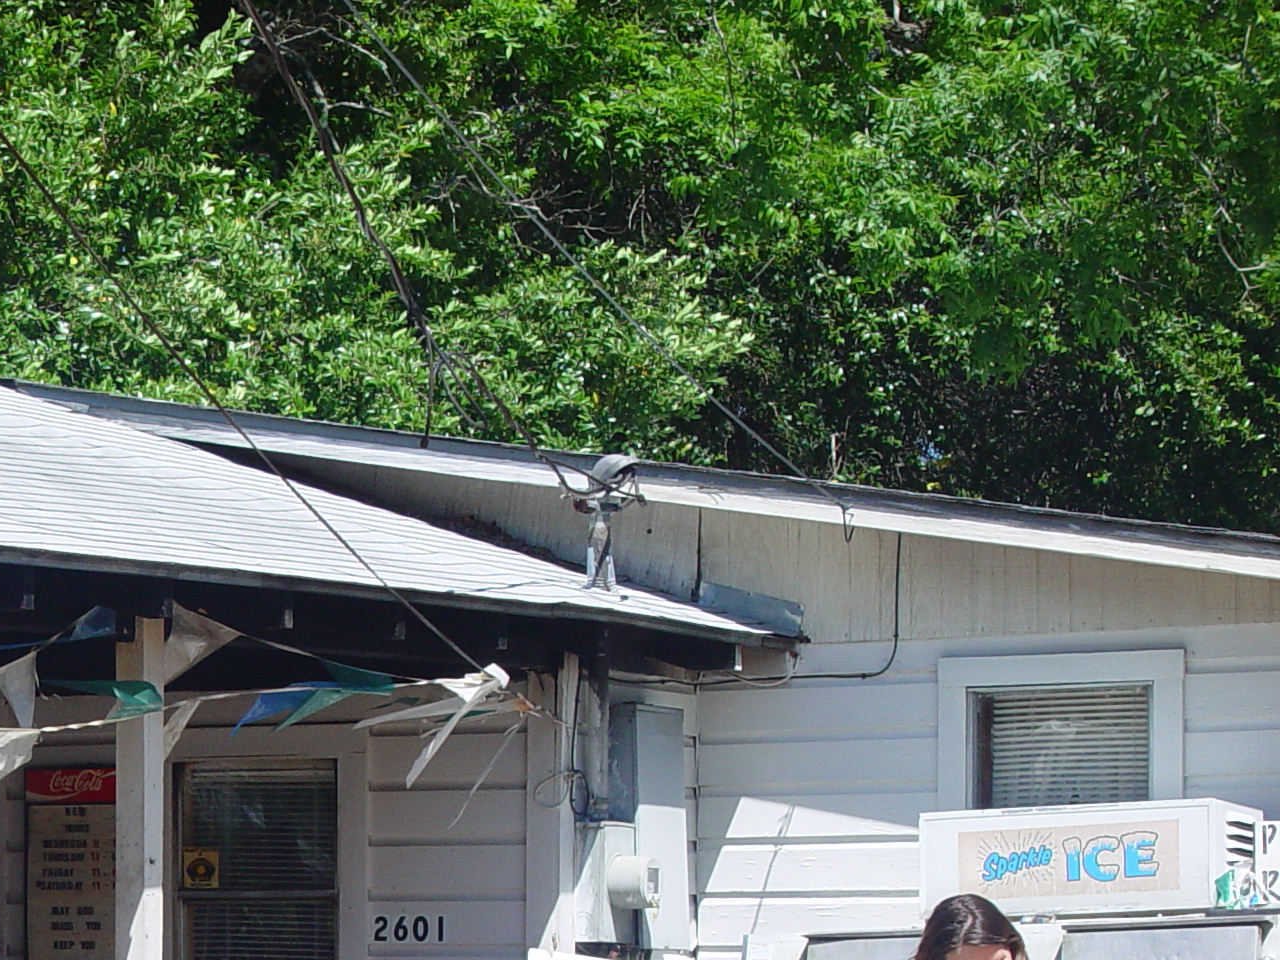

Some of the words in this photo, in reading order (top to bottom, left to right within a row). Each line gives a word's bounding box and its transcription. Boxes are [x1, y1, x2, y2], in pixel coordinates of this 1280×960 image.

[49, 768, 105, 793] Coca-Cola
[982, 846, 1053, 881] Sparkle
[1061, 830, 1160, 882] ICE
[42, 868, 74, 877] FRIDAY
[77, 906, 94, 916] GOD
[85, 922, 101, 931] YOU
[373, 915, 445, 942] 2601
[53, 940, 74, 950] KEEP
[80, 940, 96, 950] YOU
